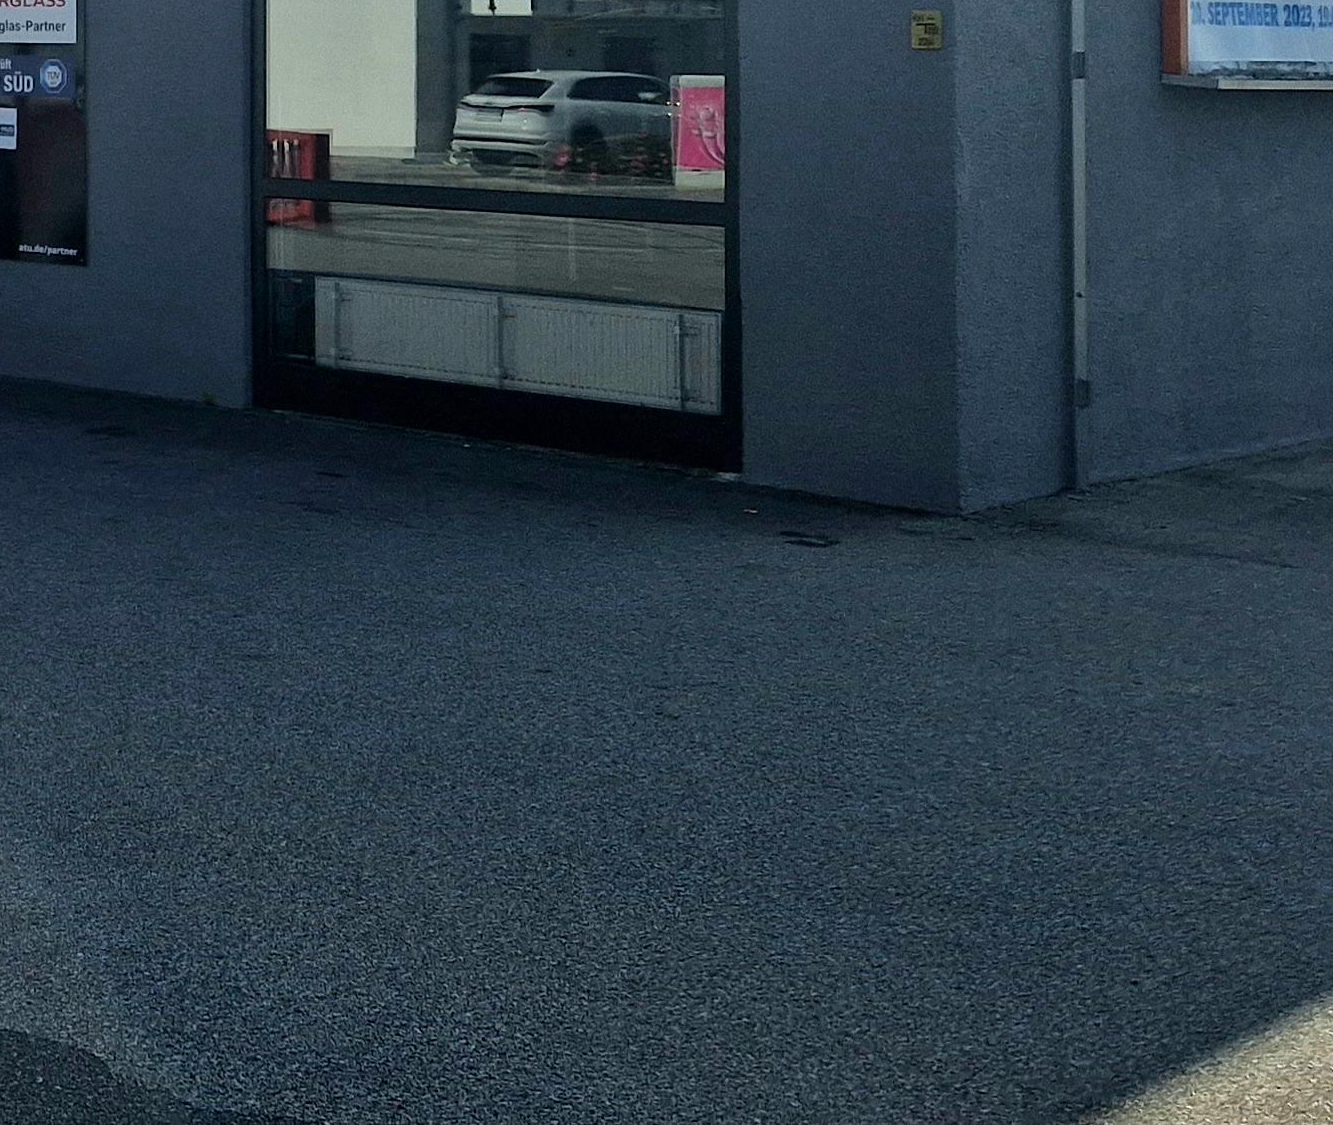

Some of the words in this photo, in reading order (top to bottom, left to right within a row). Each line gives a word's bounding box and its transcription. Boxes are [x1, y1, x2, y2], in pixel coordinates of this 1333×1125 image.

[1207, 2, 1279, 27] SEPTEMBER
[1283, 4, 1315, 31] 2023,
[3, 70, 34, 93] SÜD
[18, 244, 78, 256] atu.de/partner
